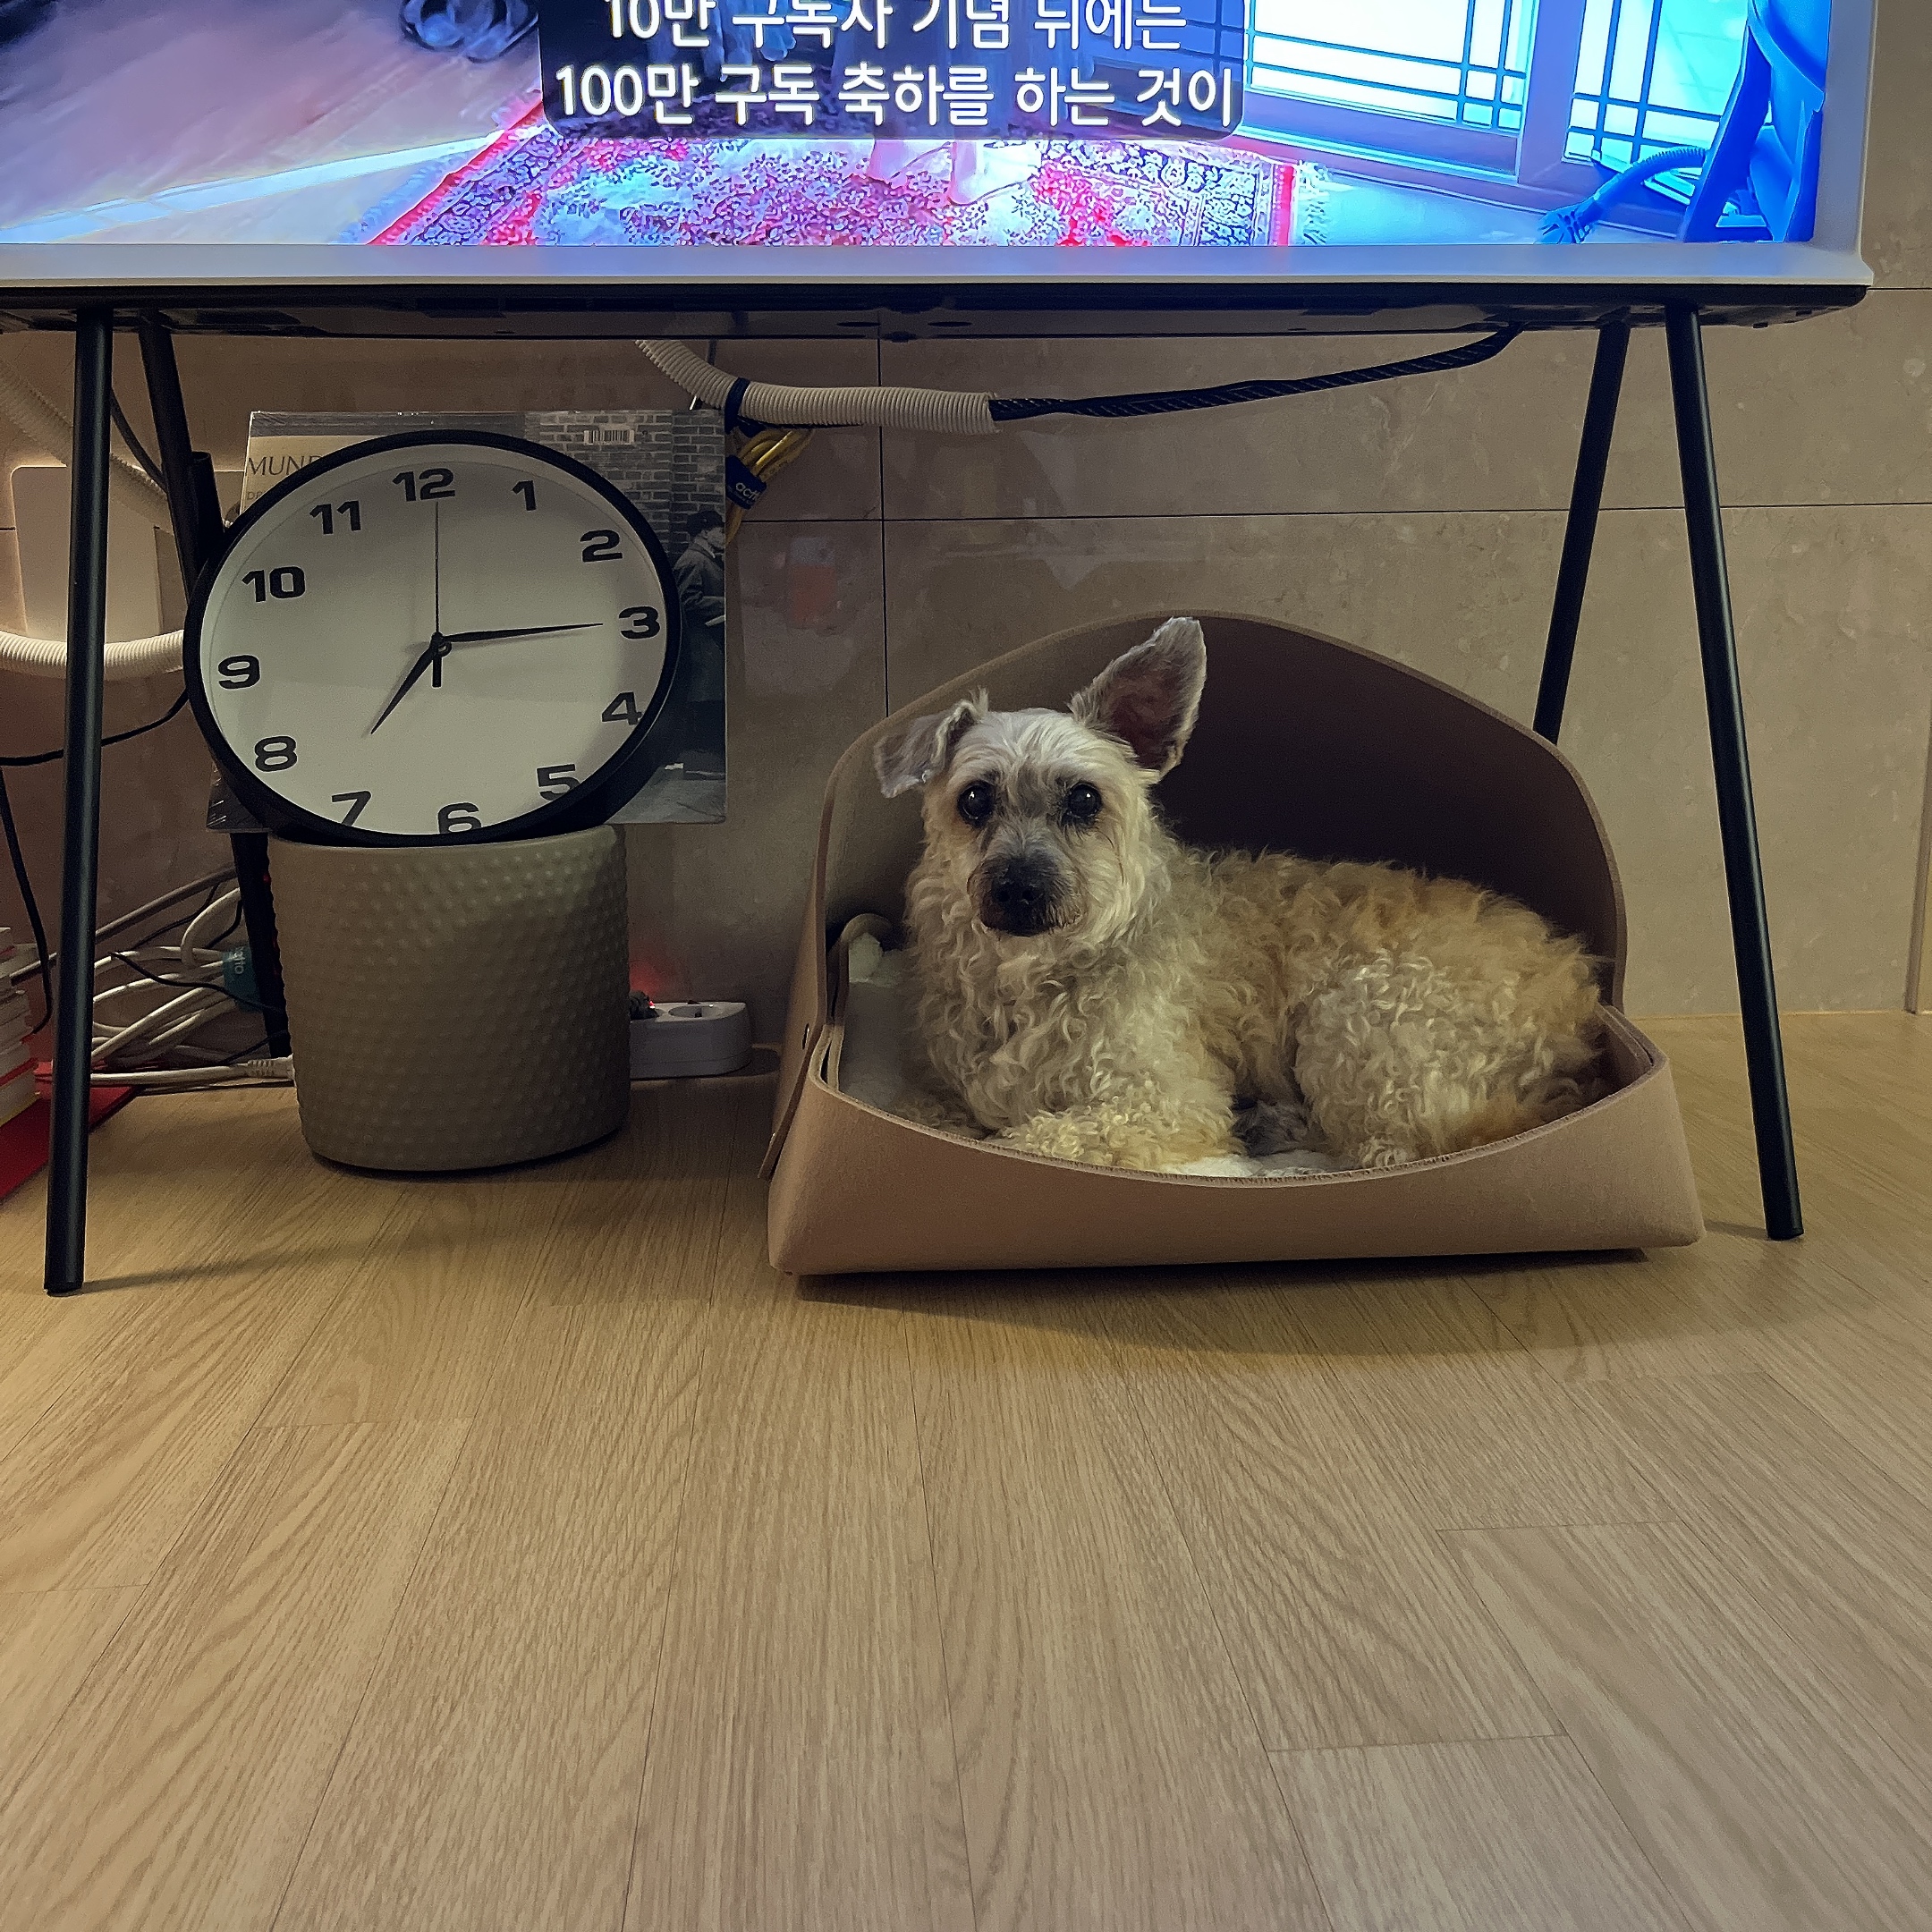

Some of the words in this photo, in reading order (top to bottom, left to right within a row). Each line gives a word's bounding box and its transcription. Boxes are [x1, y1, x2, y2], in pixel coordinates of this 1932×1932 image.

[605, 0, 716, 47] 10만
[912, 0, 1009, 49] 기념
[555, 63, 700, 124] 100만
[715, 64, 820, 126] 구독
[837, 62, 995, 126] 축하를
[1013, 66, 1115, 126] 하는
[1136, 67, 1232, 127] 것이
[393, 468, 456, 502] 12
[513, 480, 538, 511] 1
[309, 499, 361, 535] 11
[580, 529, 623, 563] 2
[242, 565, 306, 603] 10
[618, 606, 661, 640] 3
[217, 654, 261, 690] 9
[601, 691, 642, 726] 4
[254, 735, 298, 773] 8
[537, 764, 581, 801] 5
[331, 791, 372, 827] 7
[437, 802, 482, 835] 6
